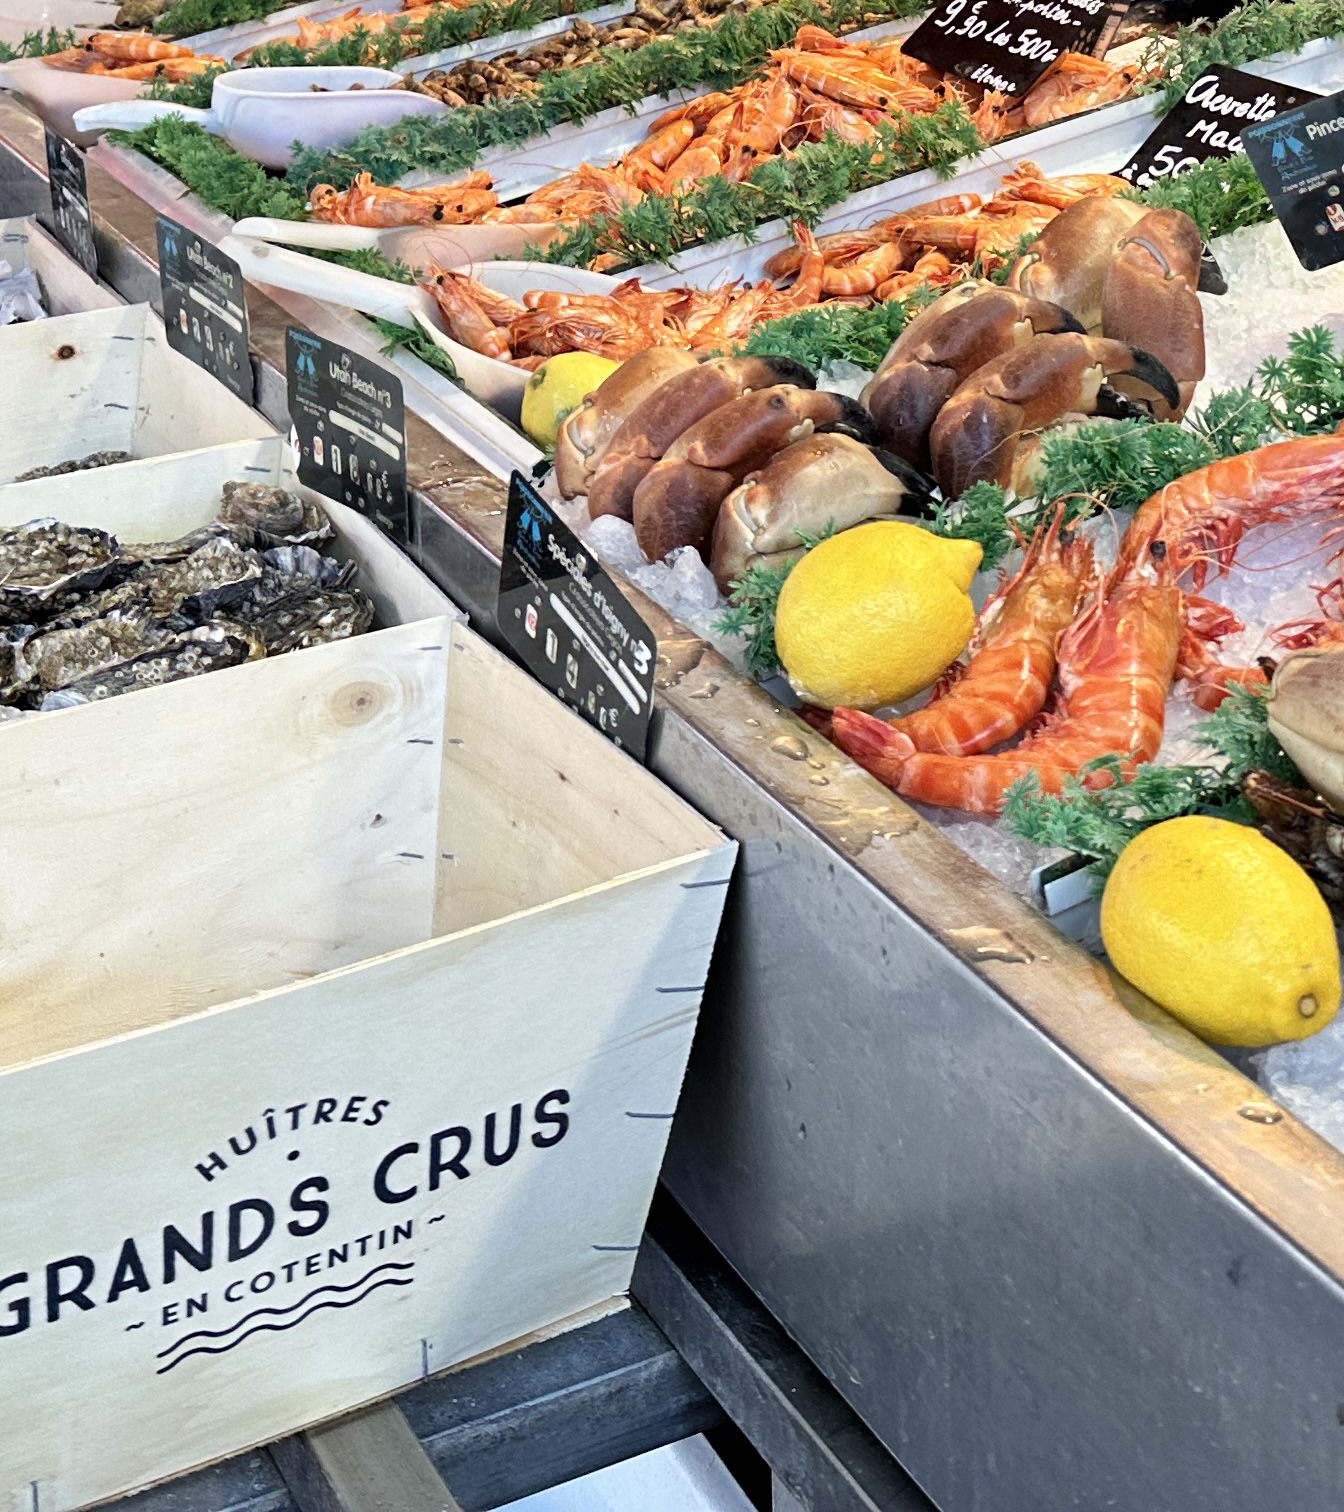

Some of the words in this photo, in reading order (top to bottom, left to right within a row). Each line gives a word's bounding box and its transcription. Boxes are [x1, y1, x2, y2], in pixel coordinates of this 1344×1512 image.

[1185, 74, 1276, 122] Crevette
[329, 361, 351, 385] Utah
[352, 372, 377, 401] Beach
[547, 533, 593, 598] Spéciales
[195, 1094, 392, 1183] HUÎTRES
[372, 1088, 573, 1206] CRUS
[161, 1296, 209, 1328] EN
[224, 1218, 415, 1304] COTENTIN
